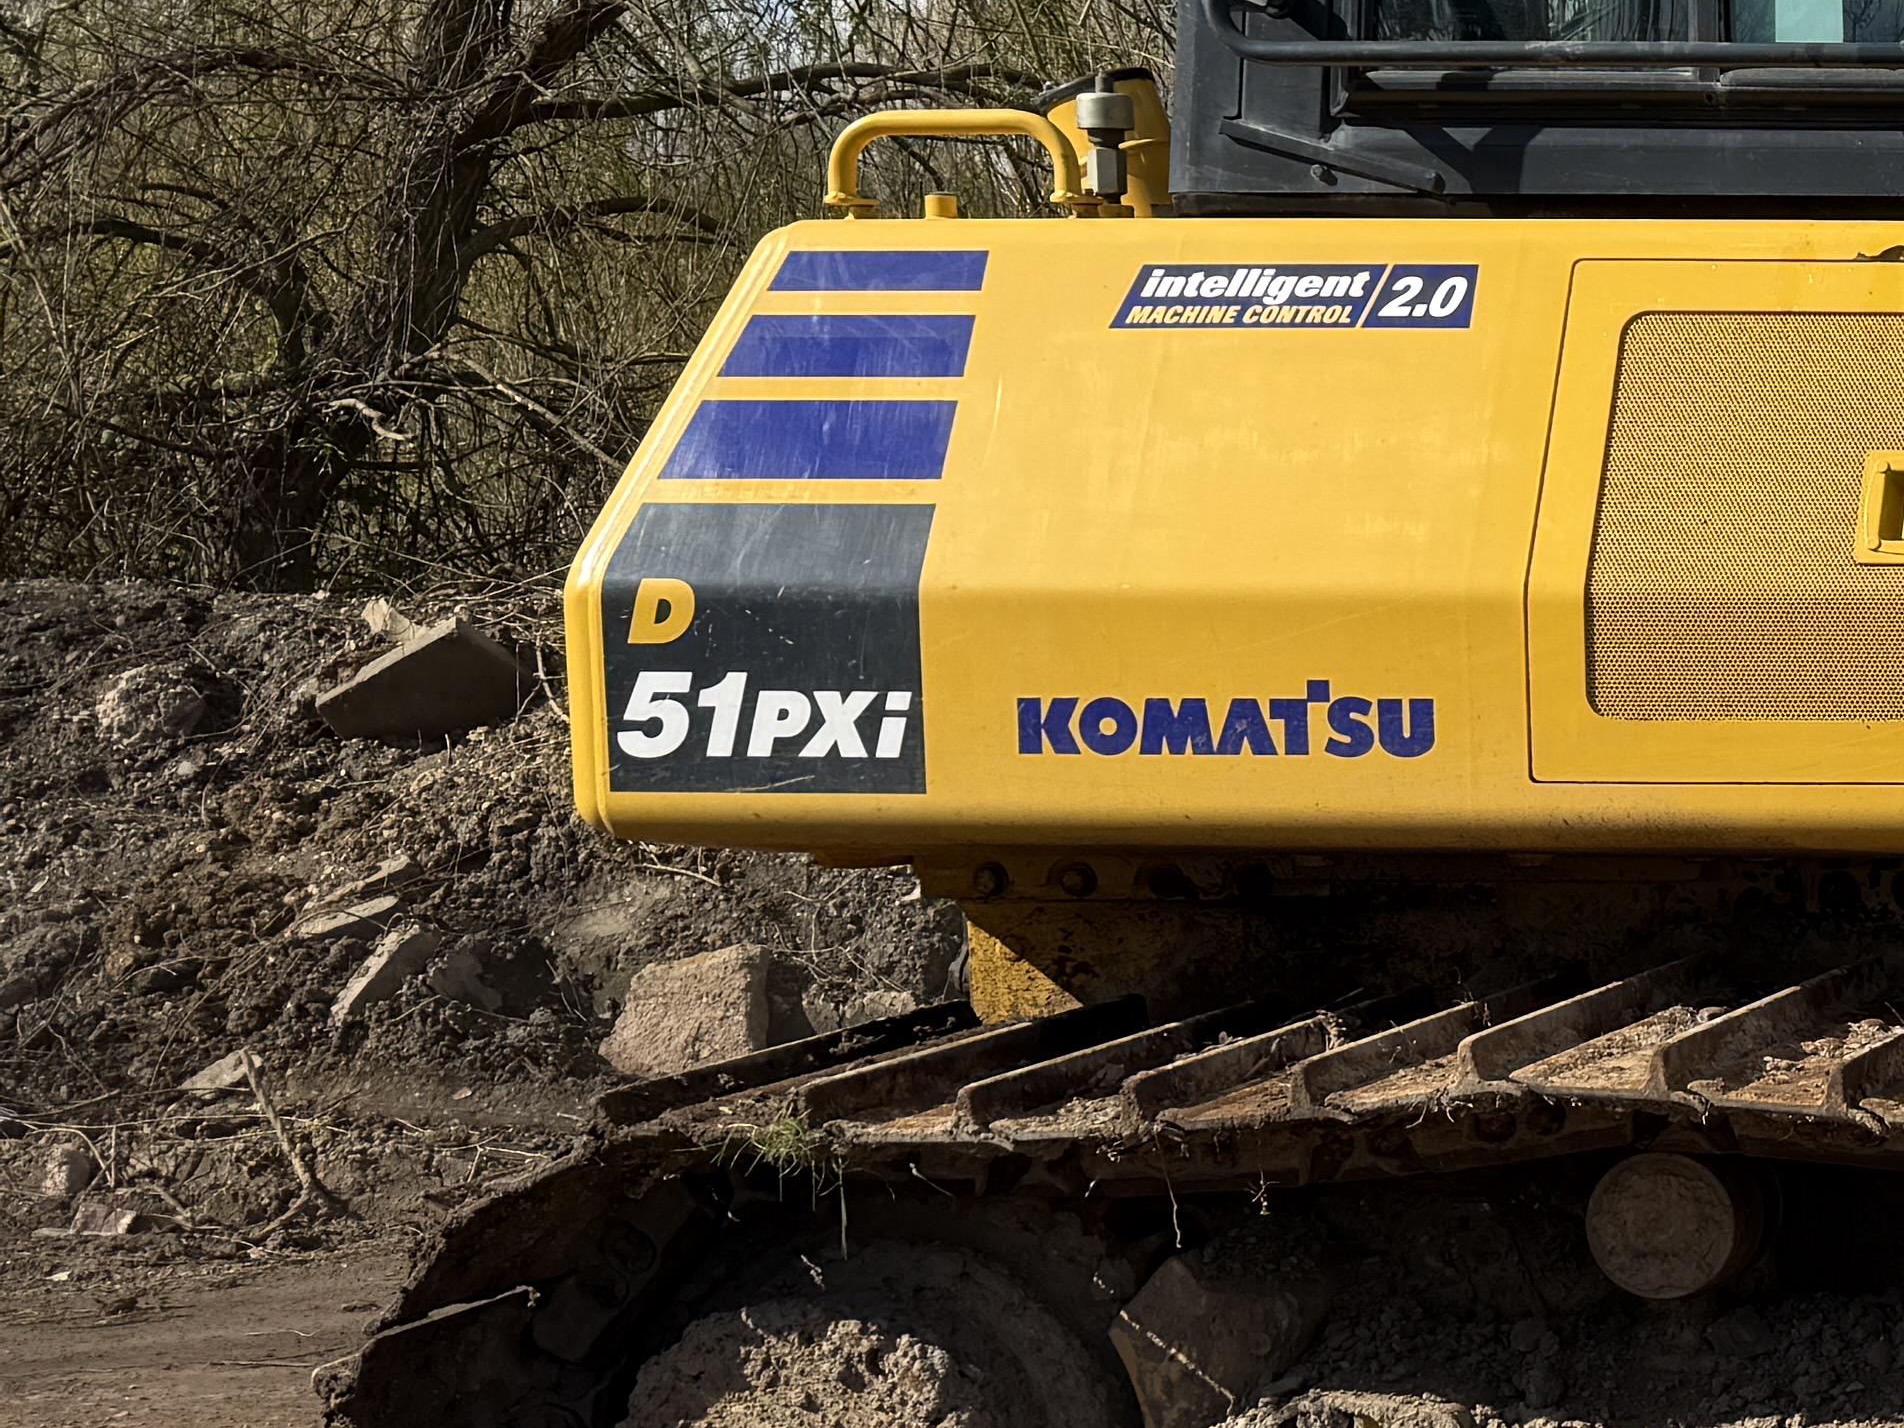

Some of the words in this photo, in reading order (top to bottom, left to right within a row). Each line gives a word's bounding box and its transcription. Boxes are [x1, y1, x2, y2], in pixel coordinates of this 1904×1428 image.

[1140, 269, 1370, 305] intelligent
[1378, 277, 1468, 317] 2.0
[1125, 305, 1236, 324] MACHINE
[1242, 304, 1352, 324] CONTROL
[627, 578, 695, 644] D
[617, 671, 912, 758] 51PXi
[1017, 679, 1435, 758] KOMATSU
